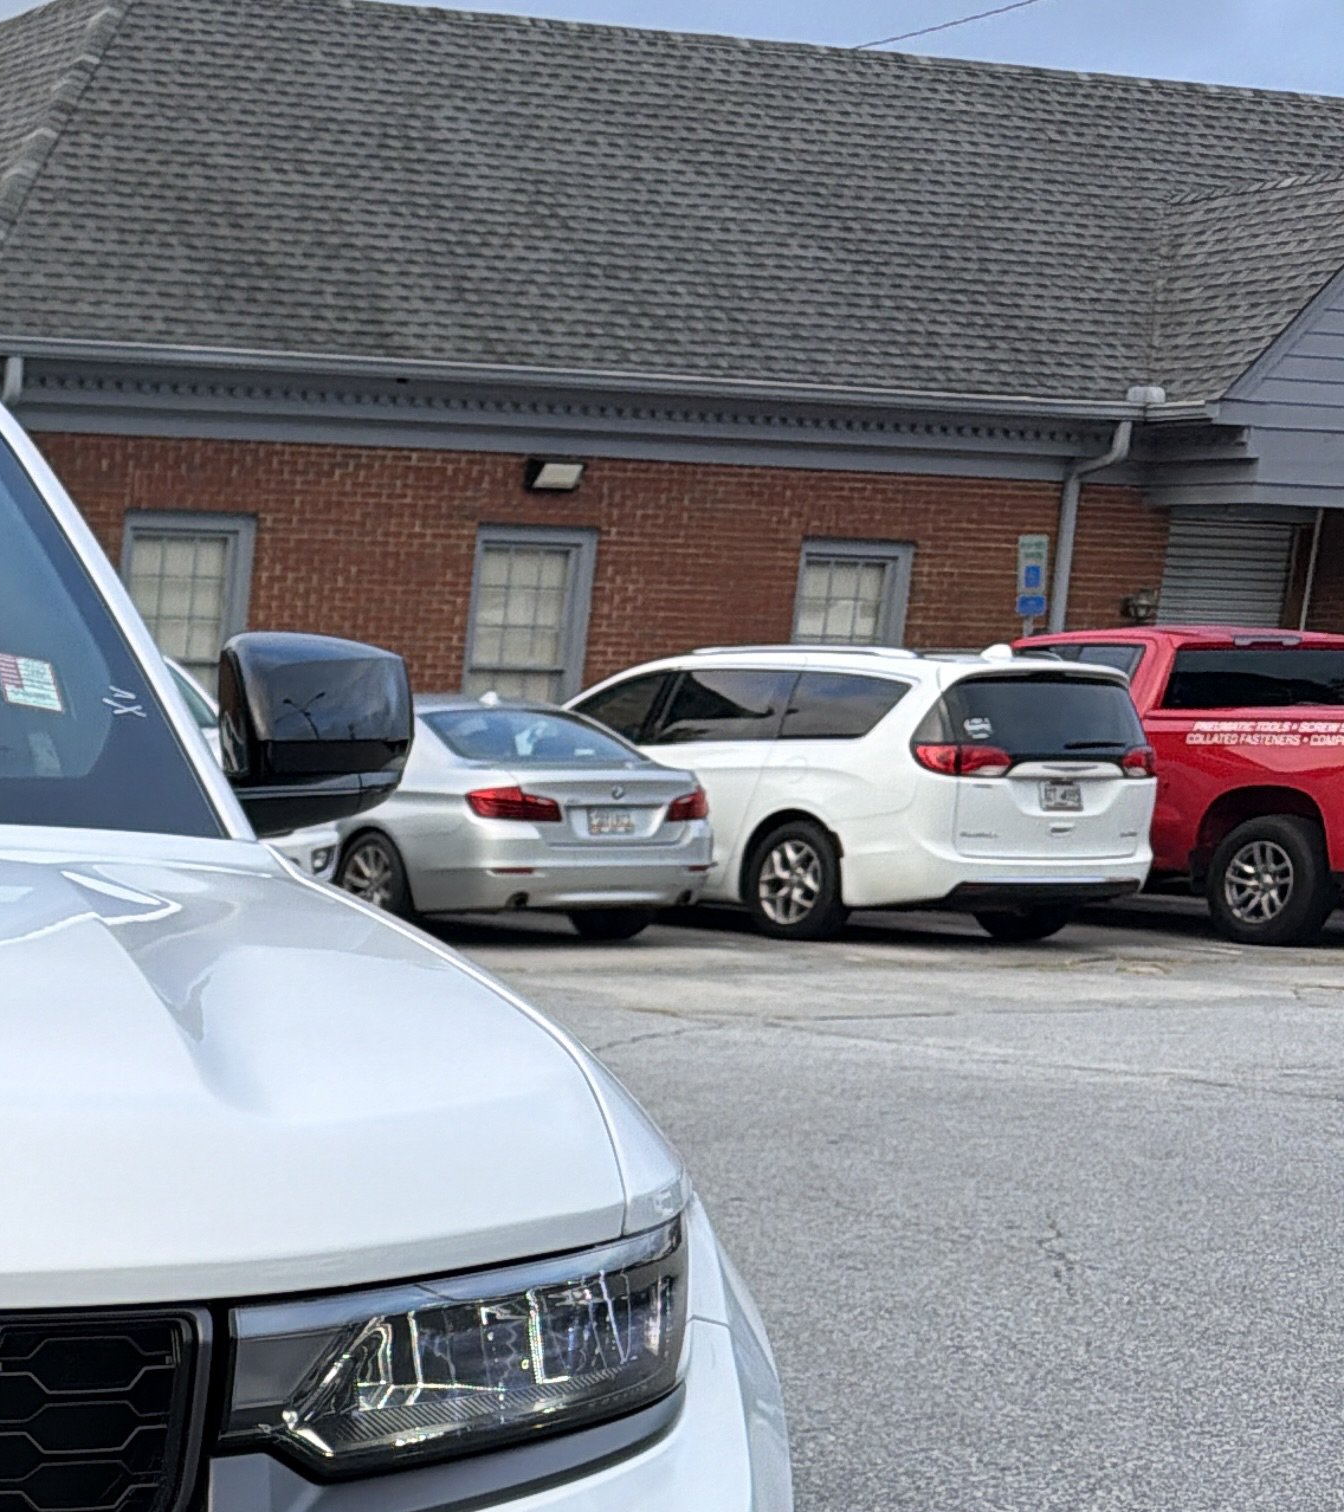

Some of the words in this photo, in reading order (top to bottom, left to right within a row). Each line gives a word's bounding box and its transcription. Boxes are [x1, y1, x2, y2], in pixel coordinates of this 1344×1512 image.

[1255, 721, 1292, 732] TOOLS
[1297, 722, 1340, 733] SCREW
[1185, 733, 1238, 745] COLLATED
[1238, 733, 1301, 746] FASTENERS
